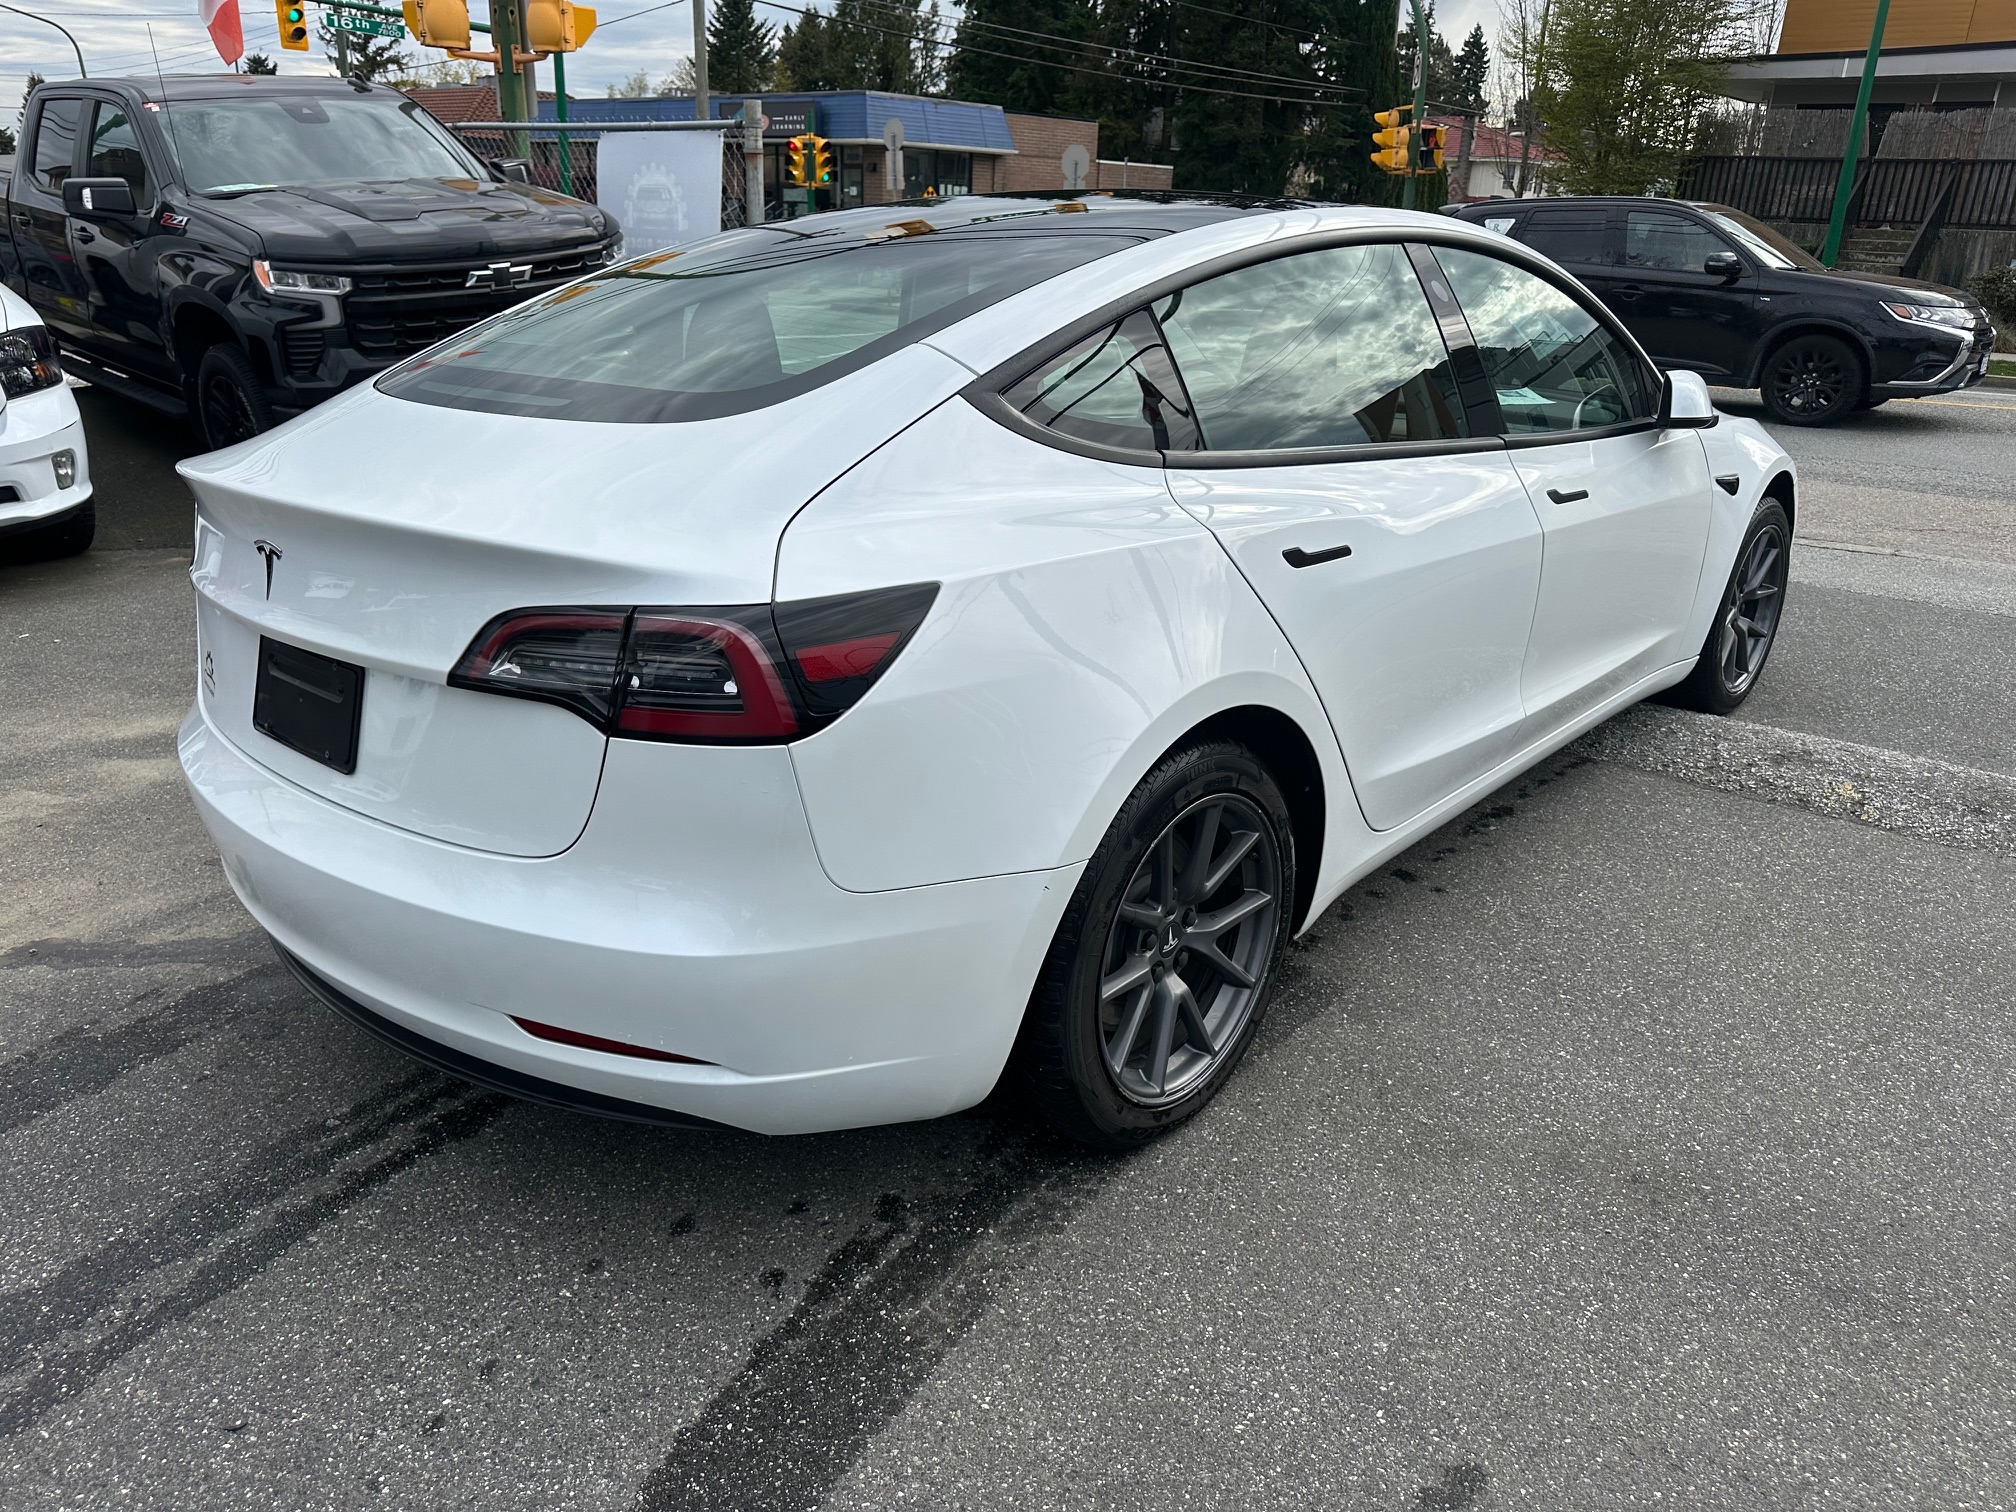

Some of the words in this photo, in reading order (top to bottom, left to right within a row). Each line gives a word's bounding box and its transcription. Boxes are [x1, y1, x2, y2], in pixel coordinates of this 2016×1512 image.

[330, 15, 370, 30] 16th
[381, 23, 398, 31] AVE
[377, 27, 402, 38] 7800
[160, 212, 191, 229] Z71
